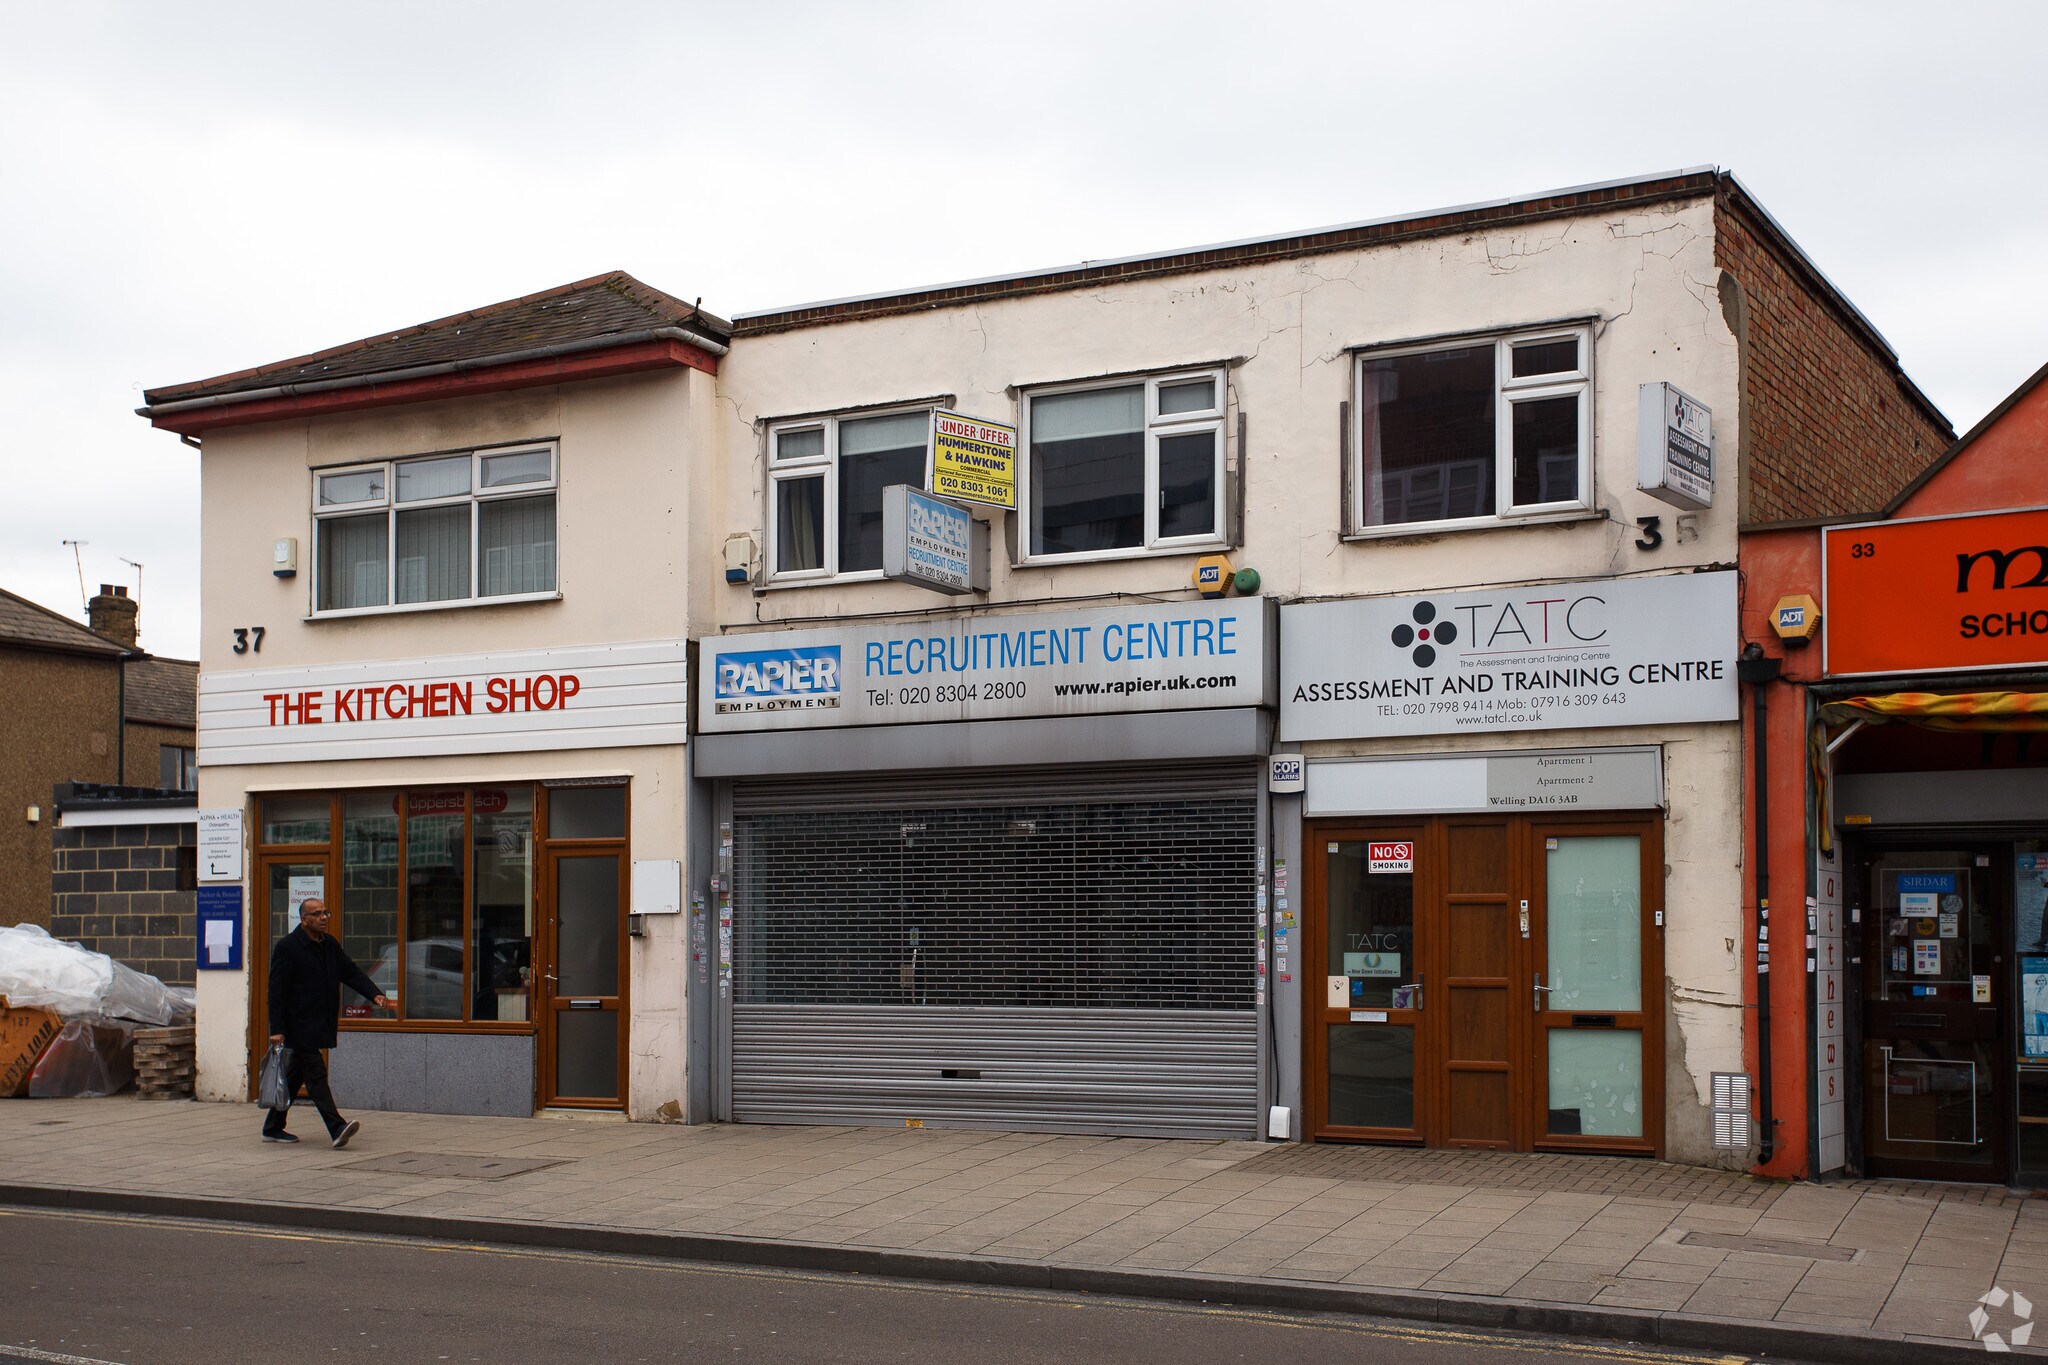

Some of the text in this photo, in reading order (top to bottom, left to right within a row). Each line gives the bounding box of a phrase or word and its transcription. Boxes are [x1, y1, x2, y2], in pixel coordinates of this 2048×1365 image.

[1684, 402, 1704, 433] TATC
[942, 420, 1010, 445] UNDER OFFER
[937, 435, 1011, 460] HUMMERSTONE
[1669, 429, 1698, 455] ASSESSMENT
[1698, 445, 1709, 461] AND
[945, 451, 1006, 472] & HAWKINS
[960, 465, 991, 476] COMMERCIAL
[1669, 447, 1692, 470] TRAINING
[1692, 460, 1710, 479] CENTRE
[941, 476, 1008, 497] 020 8303 1061
[943, 487, 1007, 503] www.hummerstone.co.uk
[910, 503, 968, 549] RAPIER
[911, 535, 967, 559] EMPLOYMENT
[1852, 543, 1875, 559] 33
[908, 546, 968, 576] RECRUITMENT CENTRE
[915, 563, 963, 586] Tel: 020 8304 2800
[1200, 569, 1219, 580] ADT
[1454, 595, 1608, 648] TATC
[1780, 610, 1804, 625] ADT
[232, 626, 265, 654] 37
[865, 617, 1238, 677] RECRUITMENT CENTRE
[1460, 651, 1611, 668] The Assessment and Training Centre
[717, 656, 838, 696] RAPIER
[1055, 673, 1238, 698] www.rapier.uk.com
[1293, 660, 1724, 703] ASSESSMENT AND TRAINING CENTRE
[263, 673, 581, 726] THE KITCHEN SHOP
[866, 681, 1027, 707] Tel: 020 8304 2800
[1377, 692, 1627, 716] TEL: 020 7998 9414 Mob: 07916 309 643
[718, 697, 838, 714] EMPLOYMENT
[1455, 709, 1542, 725] www.tatcl.co.uk
[1273, 761, 1299, 774] COP
[1536, 756, 1593, 767] Apartment 1
[1536, 775, 1594, 787] Apartment 2
[1490, 794, 1578, 806] Welling DA16 3AB
[1374, 846, 1392, 858] NO
[1904, 876, 1948, 887] SIRDAR
[294, 889, 321, 897] Temporary
[1346, 933, 1398, 950] TATC
